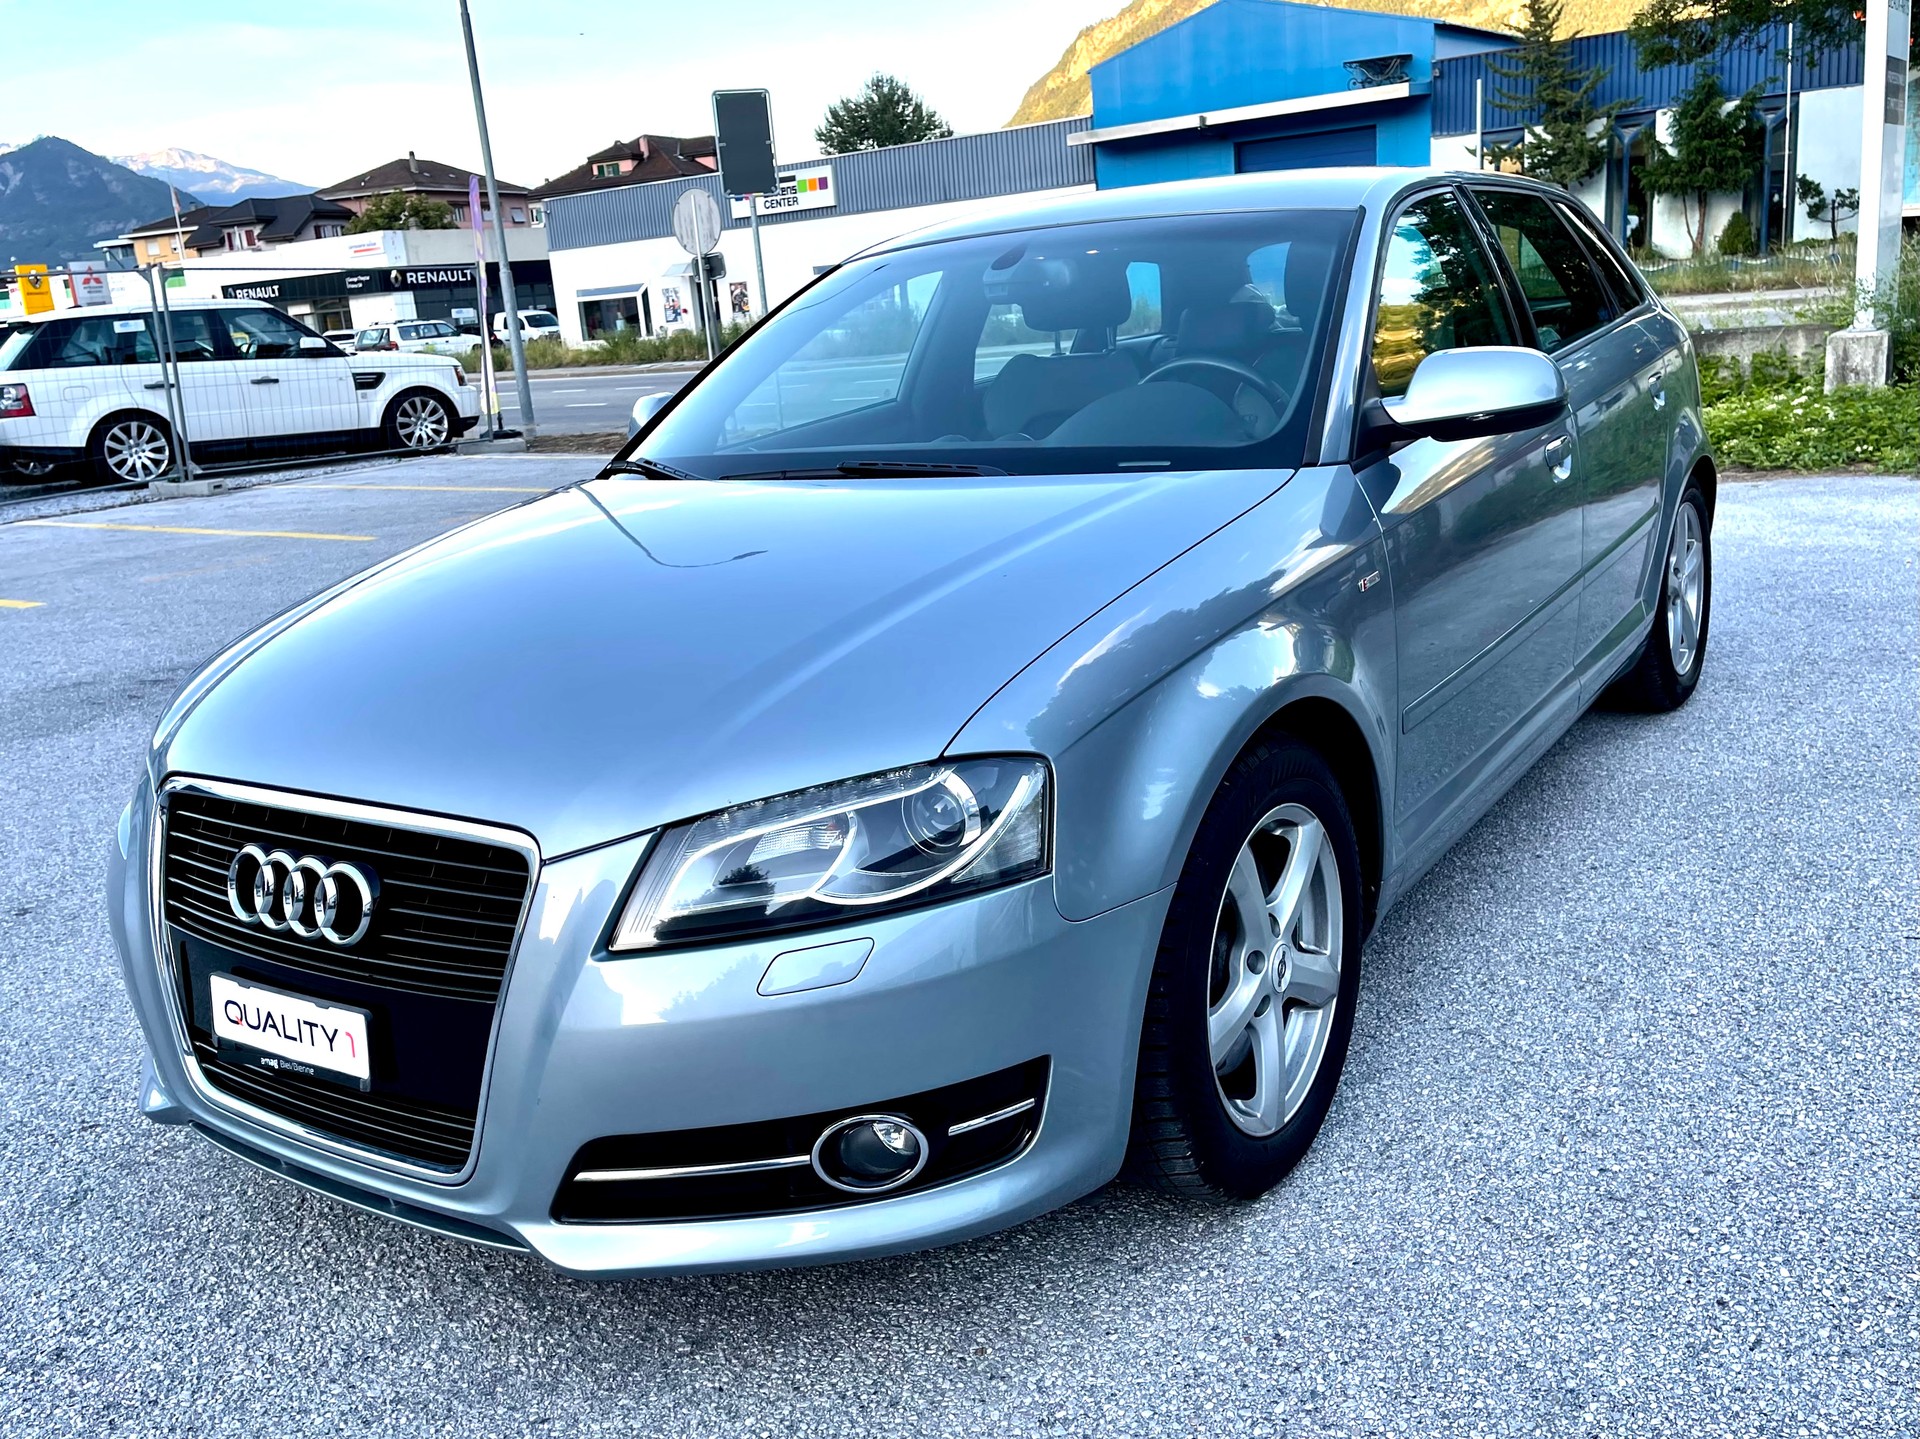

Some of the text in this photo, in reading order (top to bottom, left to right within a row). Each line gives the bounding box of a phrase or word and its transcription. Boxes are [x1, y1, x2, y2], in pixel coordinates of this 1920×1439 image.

[763, 196, 799, 210] CENTER
[405, 269, 472, 284] RENAULT
[235, 285, 280, 300] RENAULT
[224, 999, 339, 1052] QUALITY
